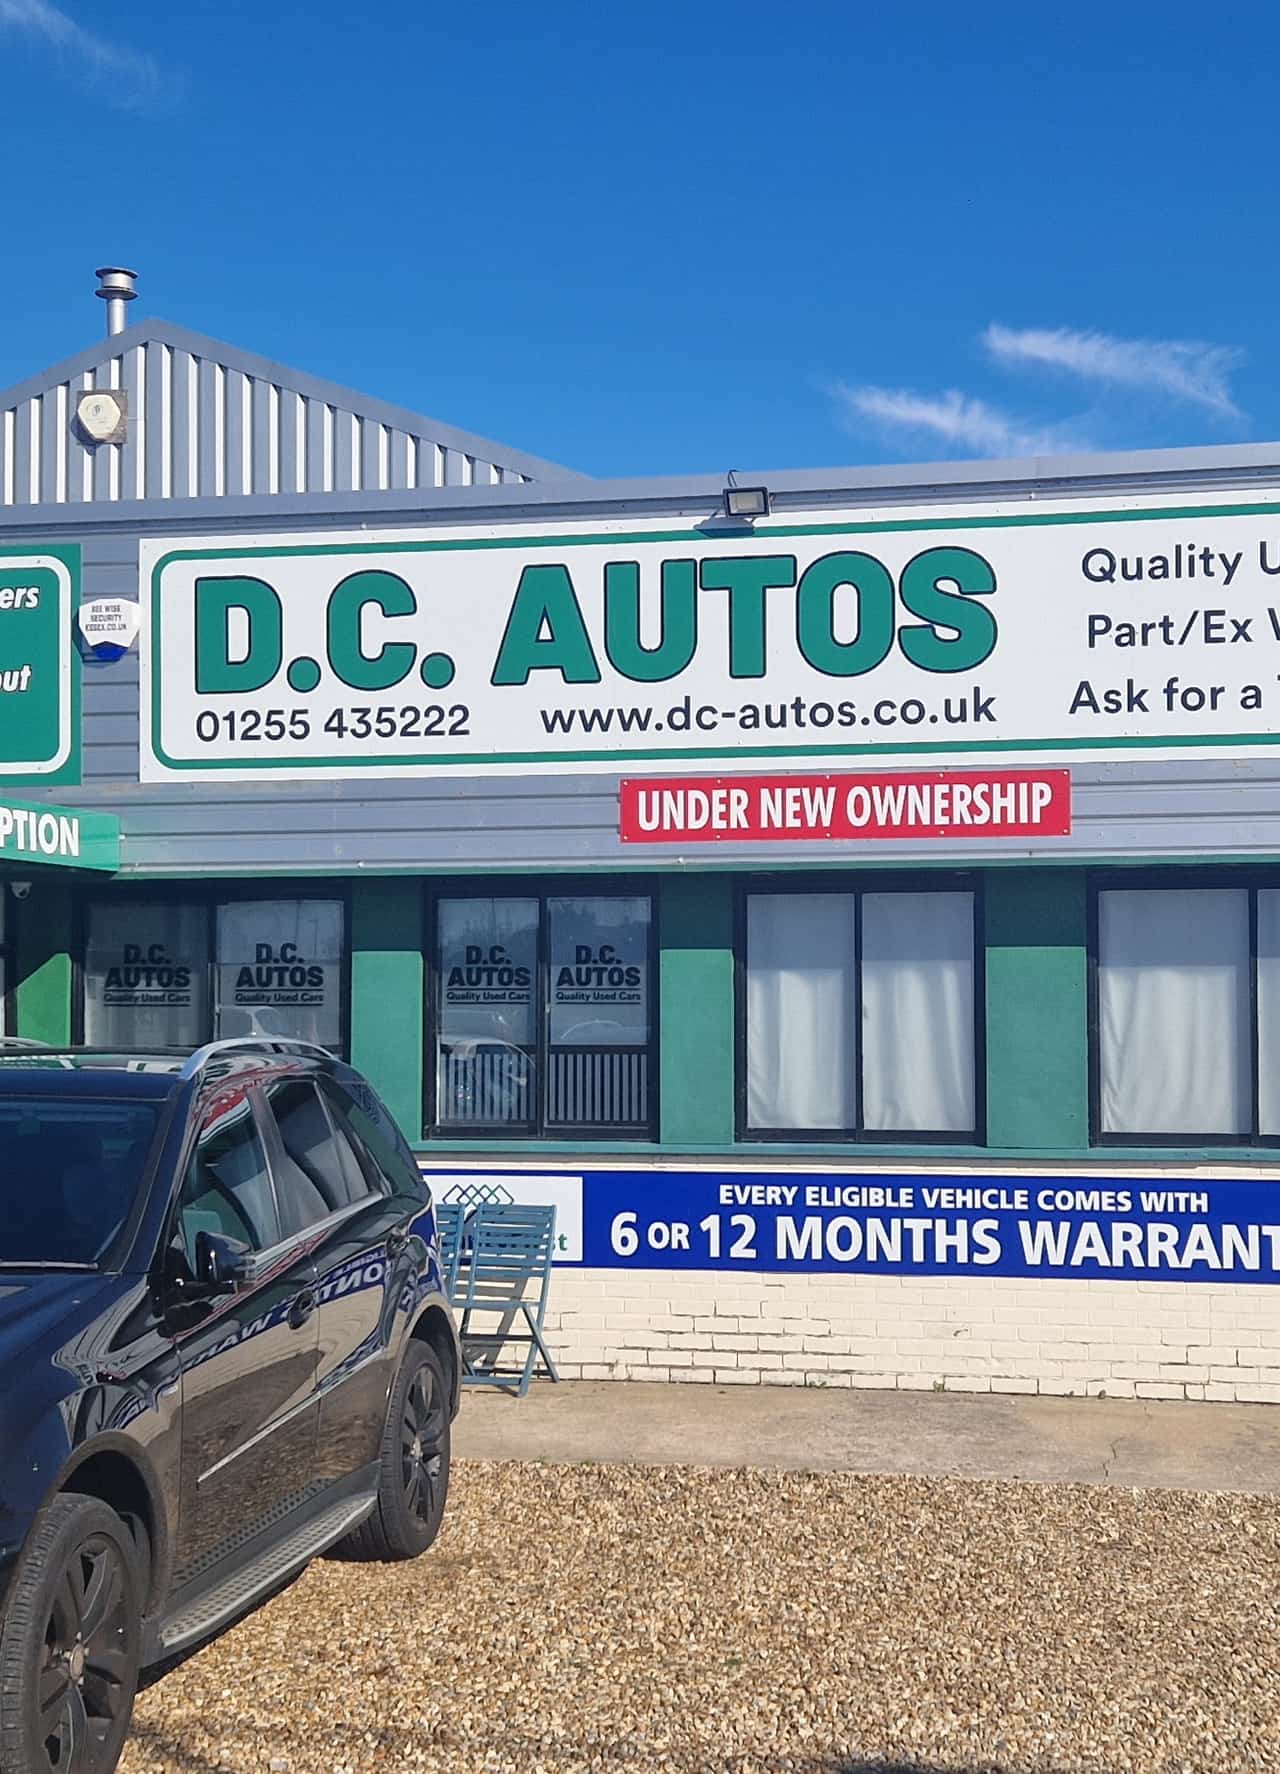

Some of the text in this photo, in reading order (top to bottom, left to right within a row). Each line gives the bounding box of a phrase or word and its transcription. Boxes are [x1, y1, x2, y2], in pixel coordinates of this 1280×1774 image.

[1081, 542, 1242, 585] Quality
[194, 546, 998, 695] D.C. AUTOS
[1088, 609, 1253, 648] Part/Ex
[1069, 679, 1150, 715] Ask
[1164, 676, 1225, 712] for
[1239, 684, 1263, 710] a
[195, 686, 998, 743] 01255 435222 www.dc-autos.co.uk
[638, 782, 1053, 834] UNDER NEW OWNERSHIP
[123, 943, 170, 965] D.C.
[255, 943, 304, 964] D.C.
[465, 945, 511, 965] D.C.
[575, 945, 622, 965] D.C.
[104, 966, 191, 988] AUTOS
[235, 966, 324, 988] AUTOS
[448, 967, 531, 987] AUTOS
[556, 967, 641, 987] AUTOS
[104, 992, 191, 1003] Quality Used Cars
[234, 992, 324, 1003] Quality Used Cars
[446, 991, 530, 1001] Quality Used Cars
[555, 991, 641, 1001] Quality Used Cars
[719, 1184, 1209, 1213] EVERY ELIGIBLE VEHICLE COMES WITH
[610, 1211, 638, 1257] 6
[647, 1221, 690, 1250] OR
[699, 1213, 757, 1259] 12
[776, 1215, 1001, 1265] MONTHS
